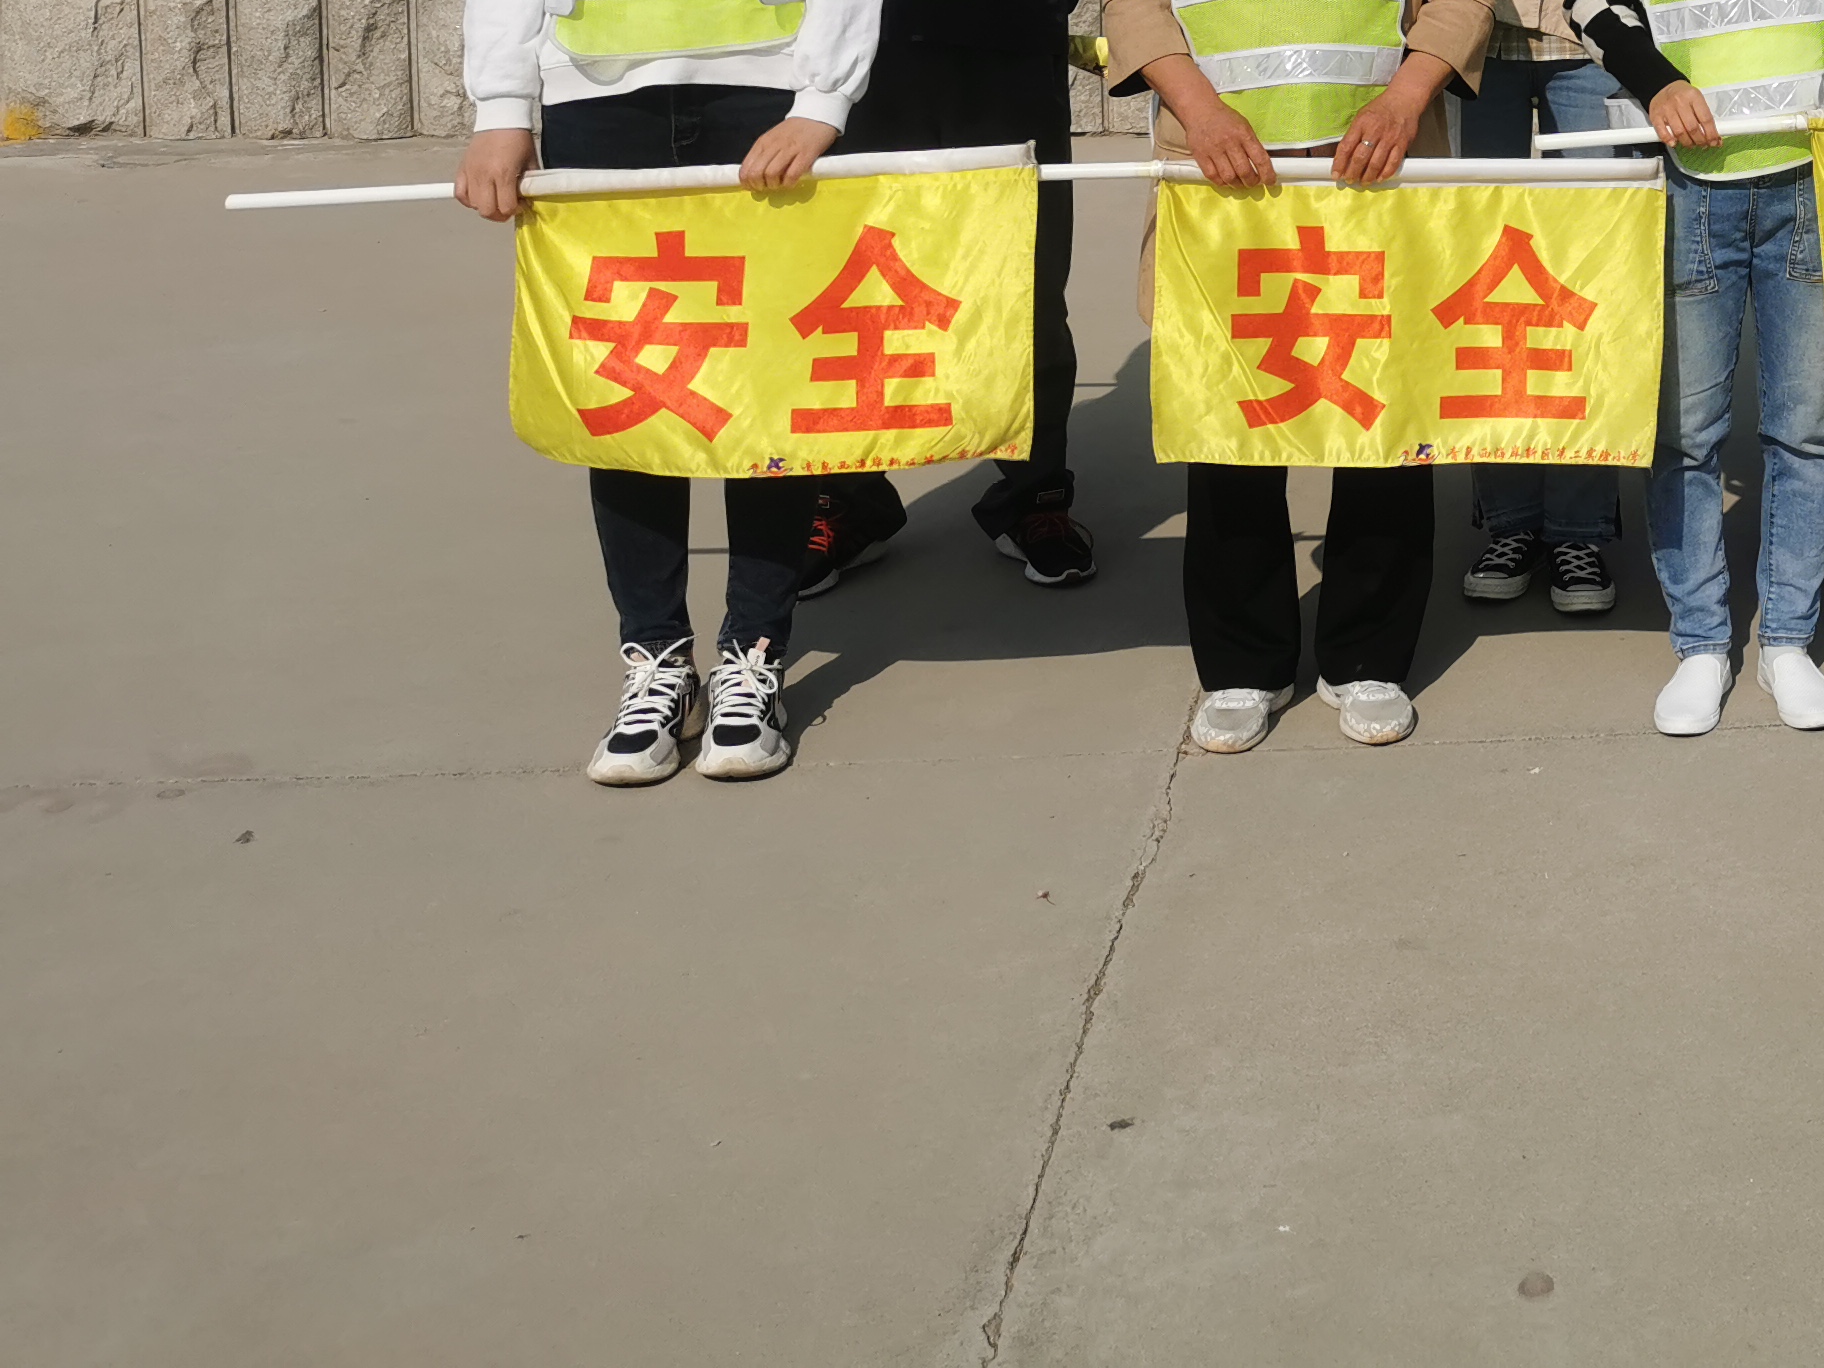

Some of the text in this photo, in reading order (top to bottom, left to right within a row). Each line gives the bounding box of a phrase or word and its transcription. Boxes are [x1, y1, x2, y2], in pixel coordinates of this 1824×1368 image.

[568, 223, 963, 444] 安全
[1230, 223, 1599, 432] 安全
[1448, 446, 1641, 465] 青岛西海岸新区第二实验小学
